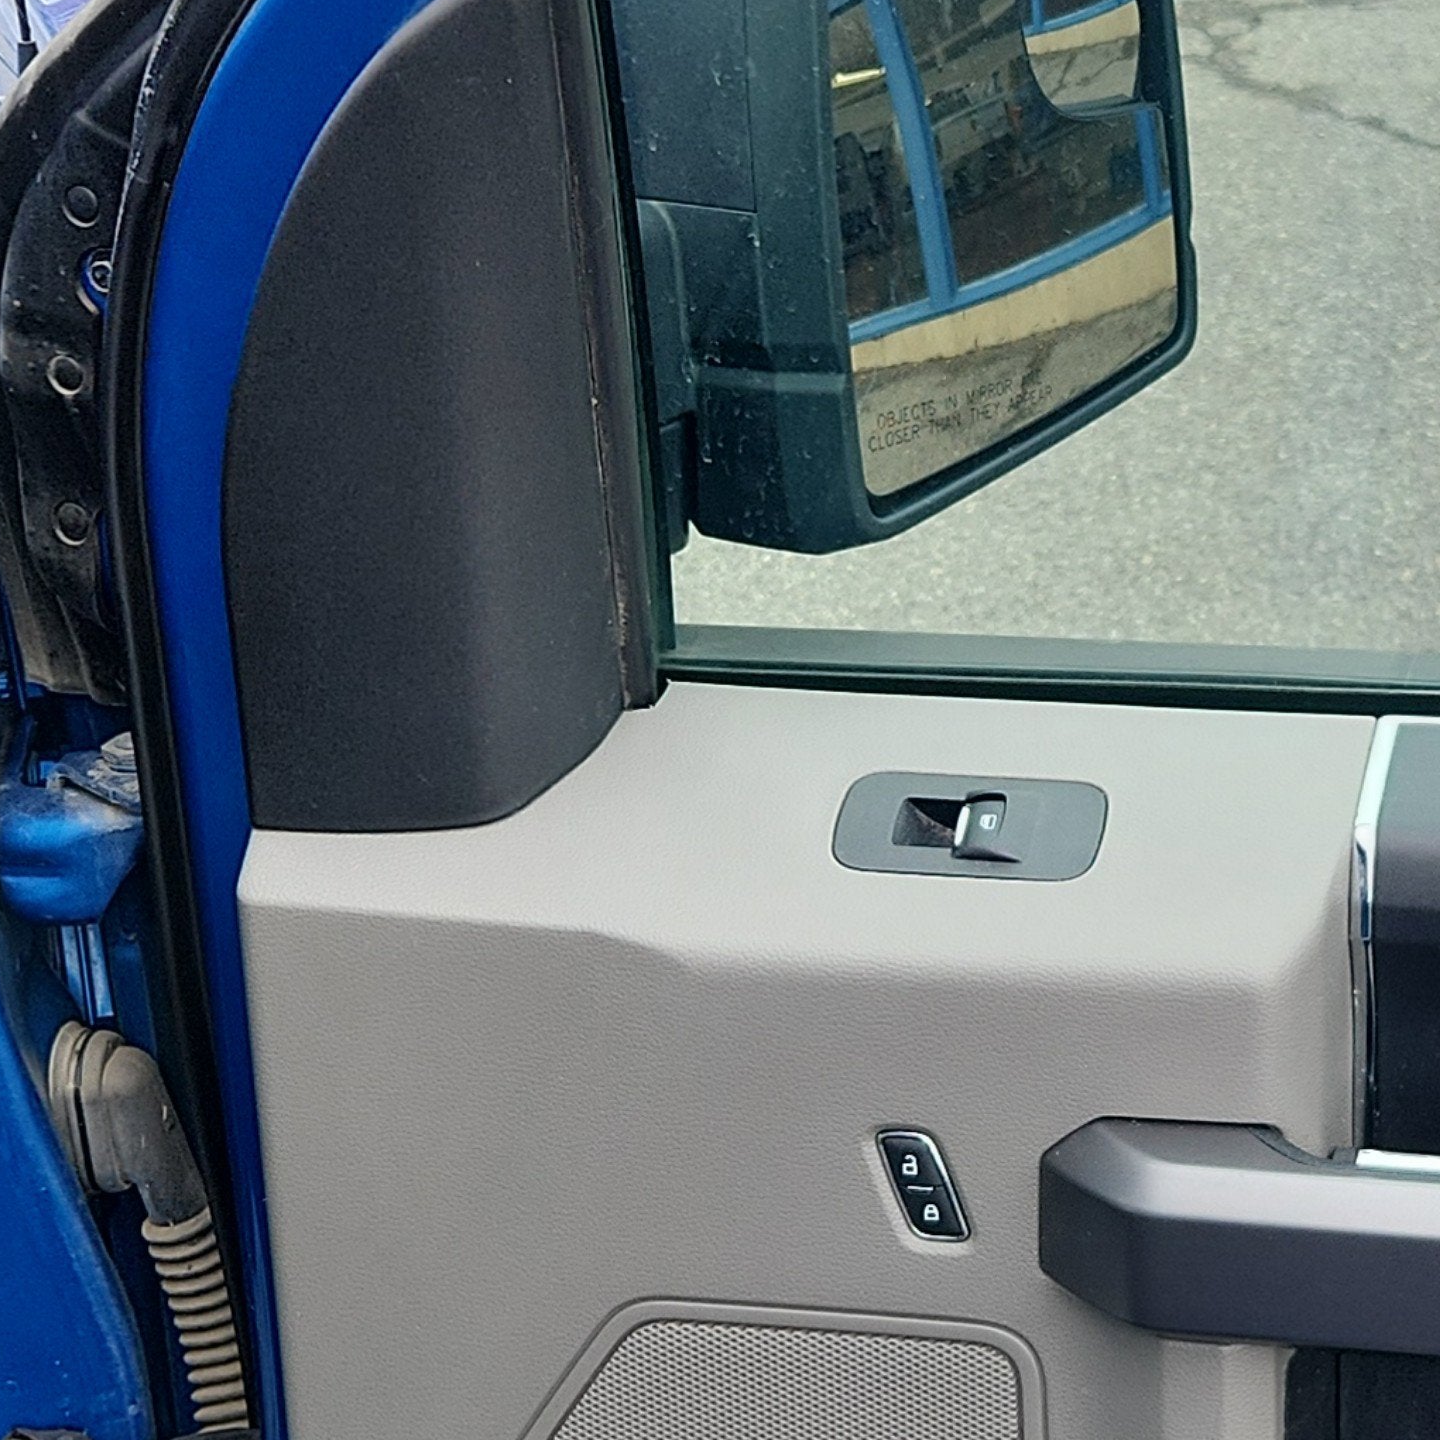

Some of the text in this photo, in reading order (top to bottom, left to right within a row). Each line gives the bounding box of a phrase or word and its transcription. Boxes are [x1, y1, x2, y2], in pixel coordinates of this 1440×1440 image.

[867, 385, 1053, 453] CLOSER THAN THEY APPEAR
[876, 399, 937, 429] OBJECTS
[946, 395, 958, 409] IN
[966, 379, 1013, 406] MIRROR
